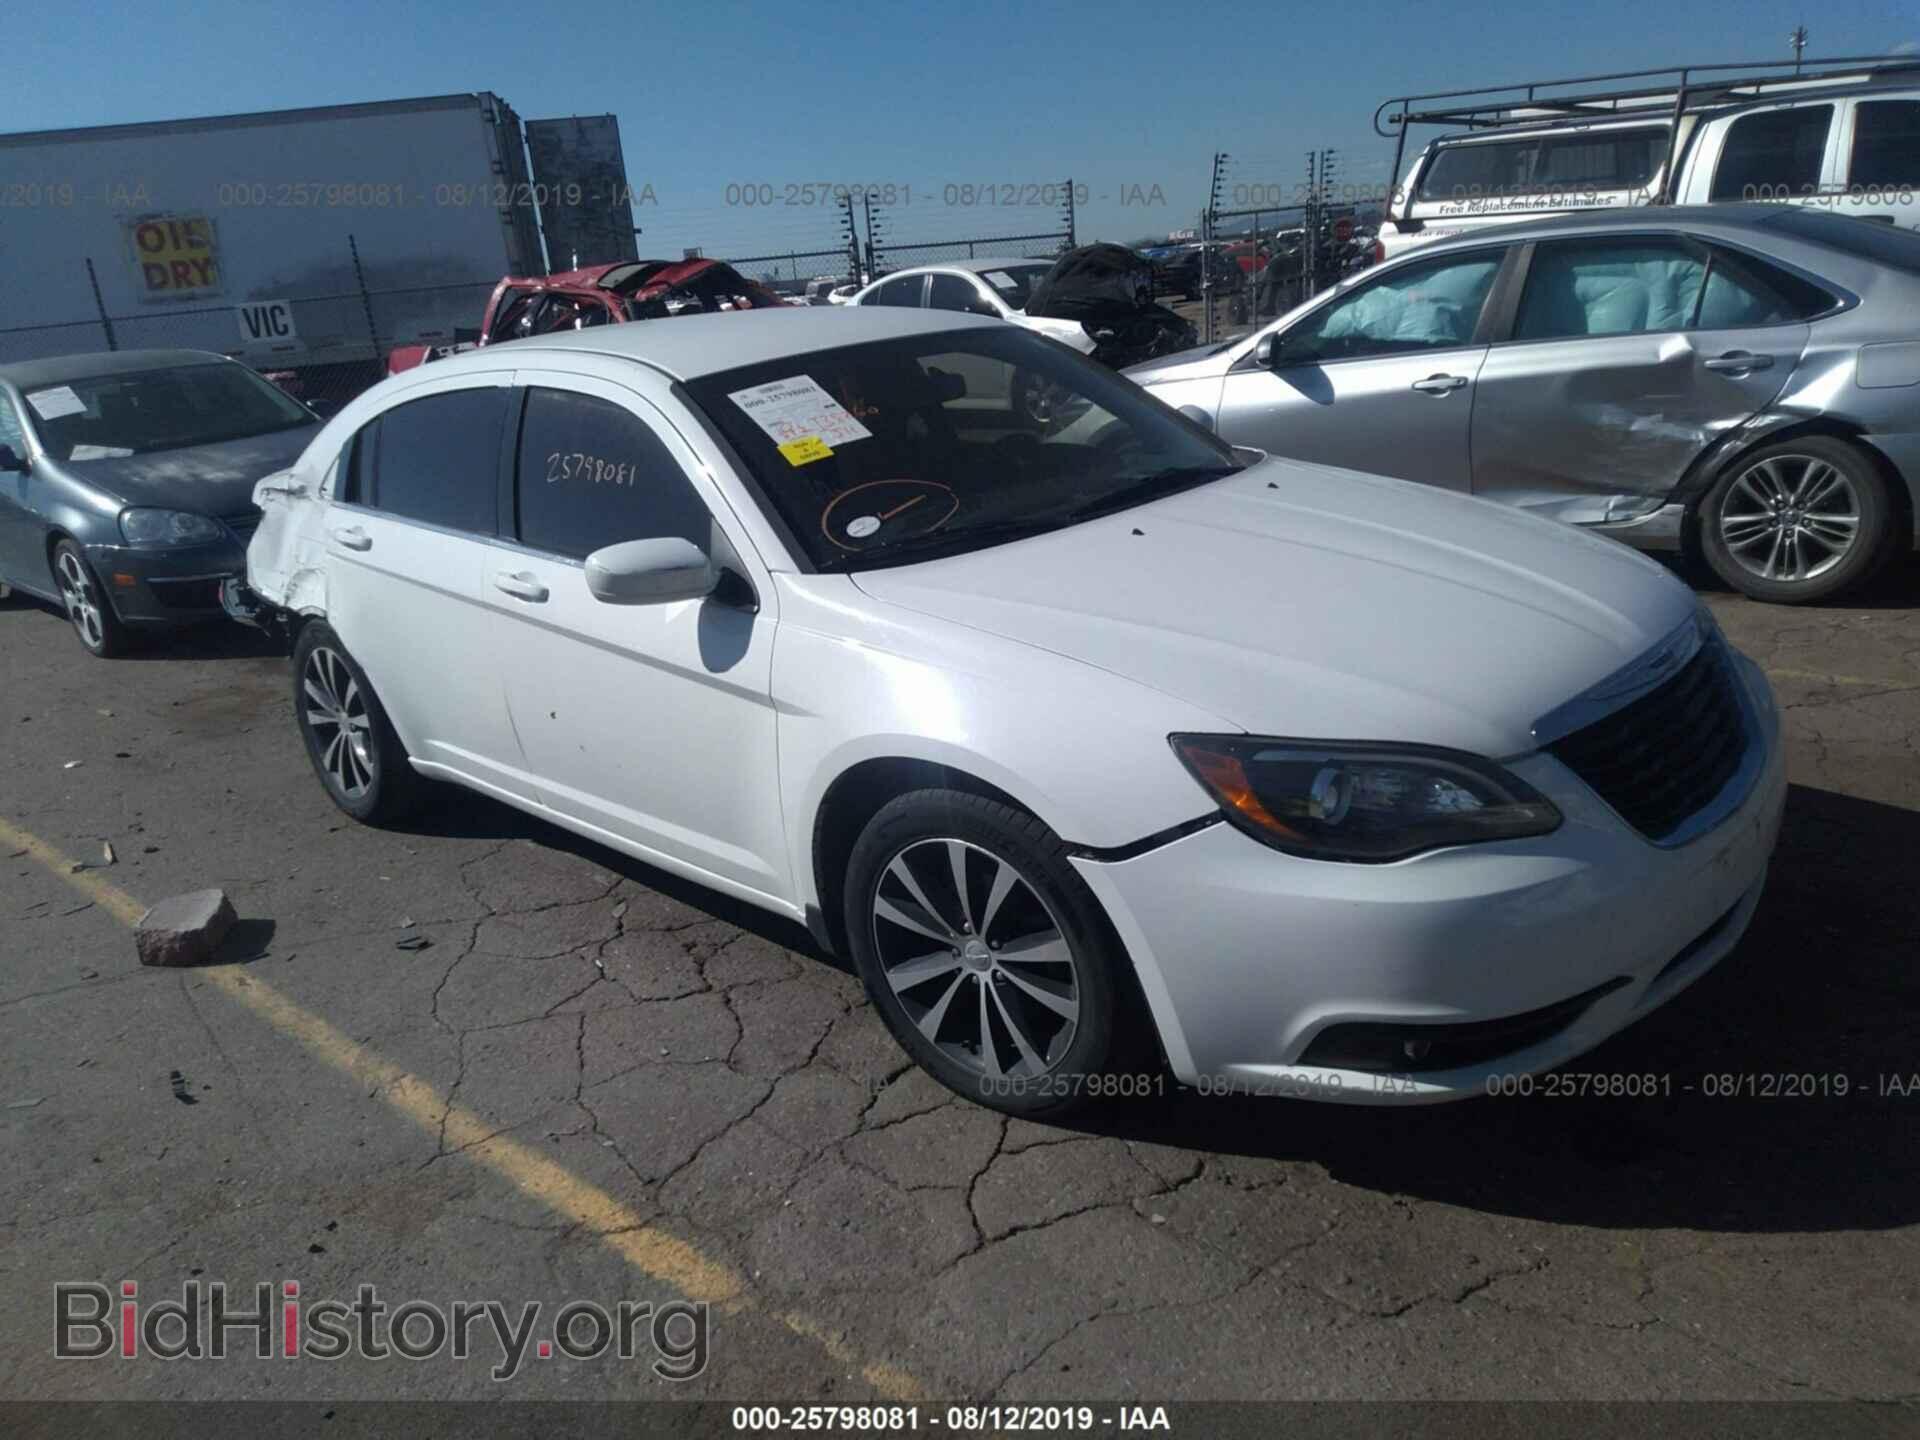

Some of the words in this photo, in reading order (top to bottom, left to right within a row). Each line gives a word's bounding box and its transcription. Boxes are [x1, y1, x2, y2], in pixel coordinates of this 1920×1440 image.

[1440, 204, 1464, 215] Free
[143, 257, 213, 290] DRY
[241, 304, 289, 339] VIC
